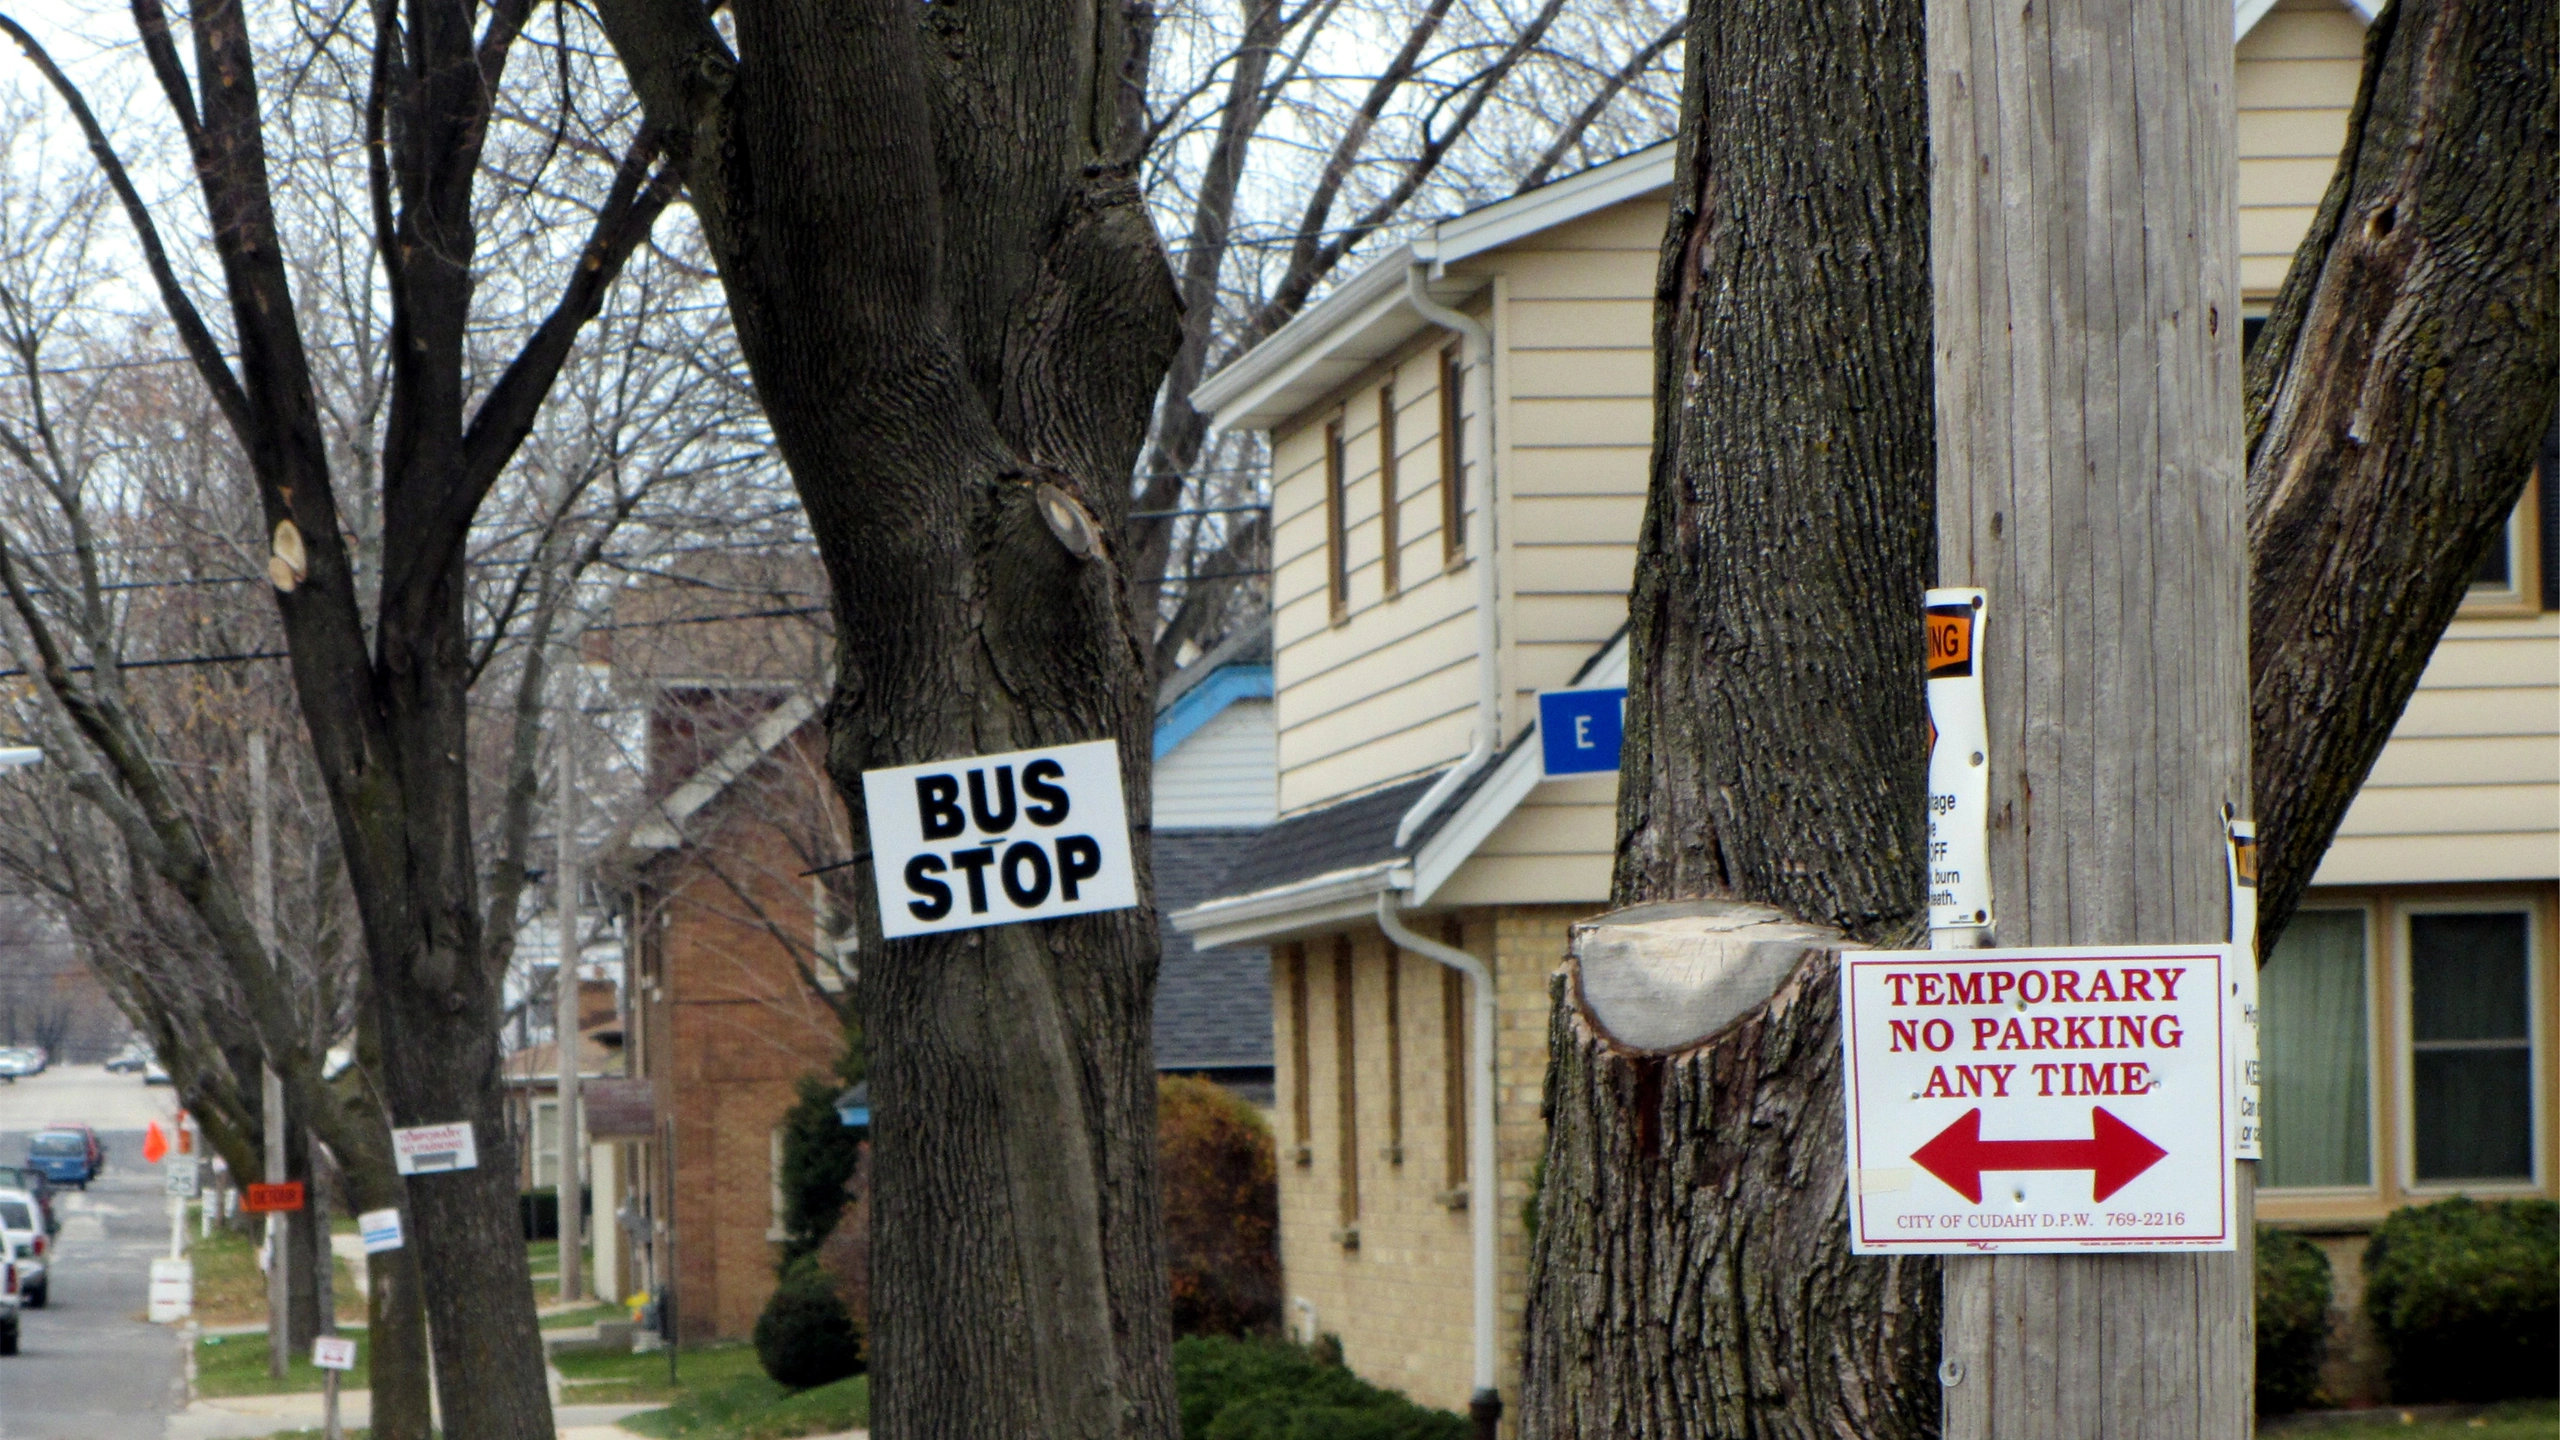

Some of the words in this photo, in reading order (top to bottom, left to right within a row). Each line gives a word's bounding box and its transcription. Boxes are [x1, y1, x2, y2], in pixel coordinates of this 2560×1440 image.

[1575, 715, 1595, 749] E
[915, 758, 1070, 841] BUS
[904, 834, 1101, 921] STOP
[1935, 868, 1960, 885] burn
[1884, 967, 2187, 1007] TEMPORARY
[1888, 1018, 1955, 1053] NO
[1971, 1013, 2184, 1052] PARKING
[1921, 1063, 2017, 1099] ANY
[2031, 1061, 2153, 1097] TIME
[1896, 1214, 1936, 1229] CITY
[1940, 1214, 1963, 1228] OF
[1966, 1213, 2038, 1229] CUDAHY
[2042, 1213, 2094, 1228] D.P.W.
[2105, 1211, 2186, 1227] 769-2216
